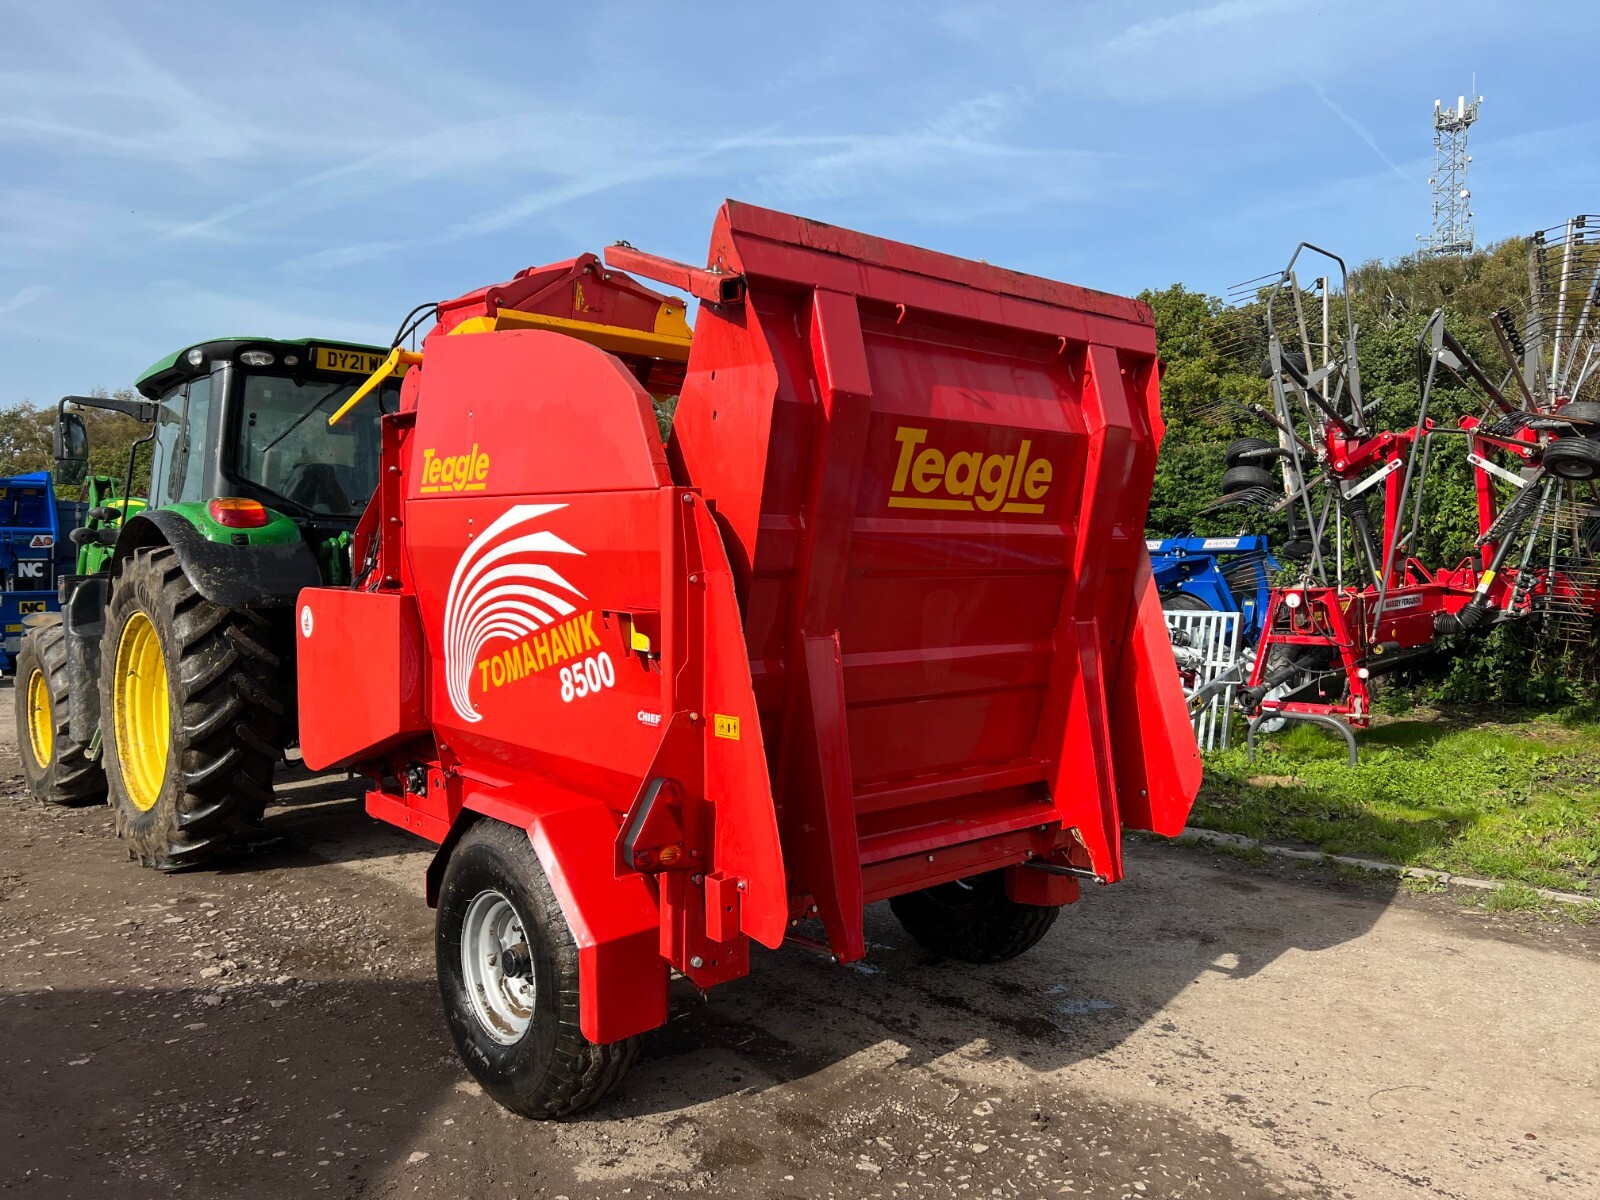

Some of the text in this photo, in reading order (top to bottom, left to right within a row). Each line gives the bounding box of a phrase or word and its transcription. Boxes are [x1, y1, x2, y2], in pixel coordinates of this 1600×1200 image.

[327, 352, 363, 370] DY21
[421, 443, 490, 491] Teagle
[892, 426, 1053, 512] Teagle
[18, 562, 43, 577] NC
[21, 602, 43, 612] NC
[1385, 596, 1421, 608] MASSEY FERGUSON
[478, 610, 601, 692] TOMAHAWK
[559, 651, 615, 702] 8500
[637, 710, 661, 724] CHIEF
